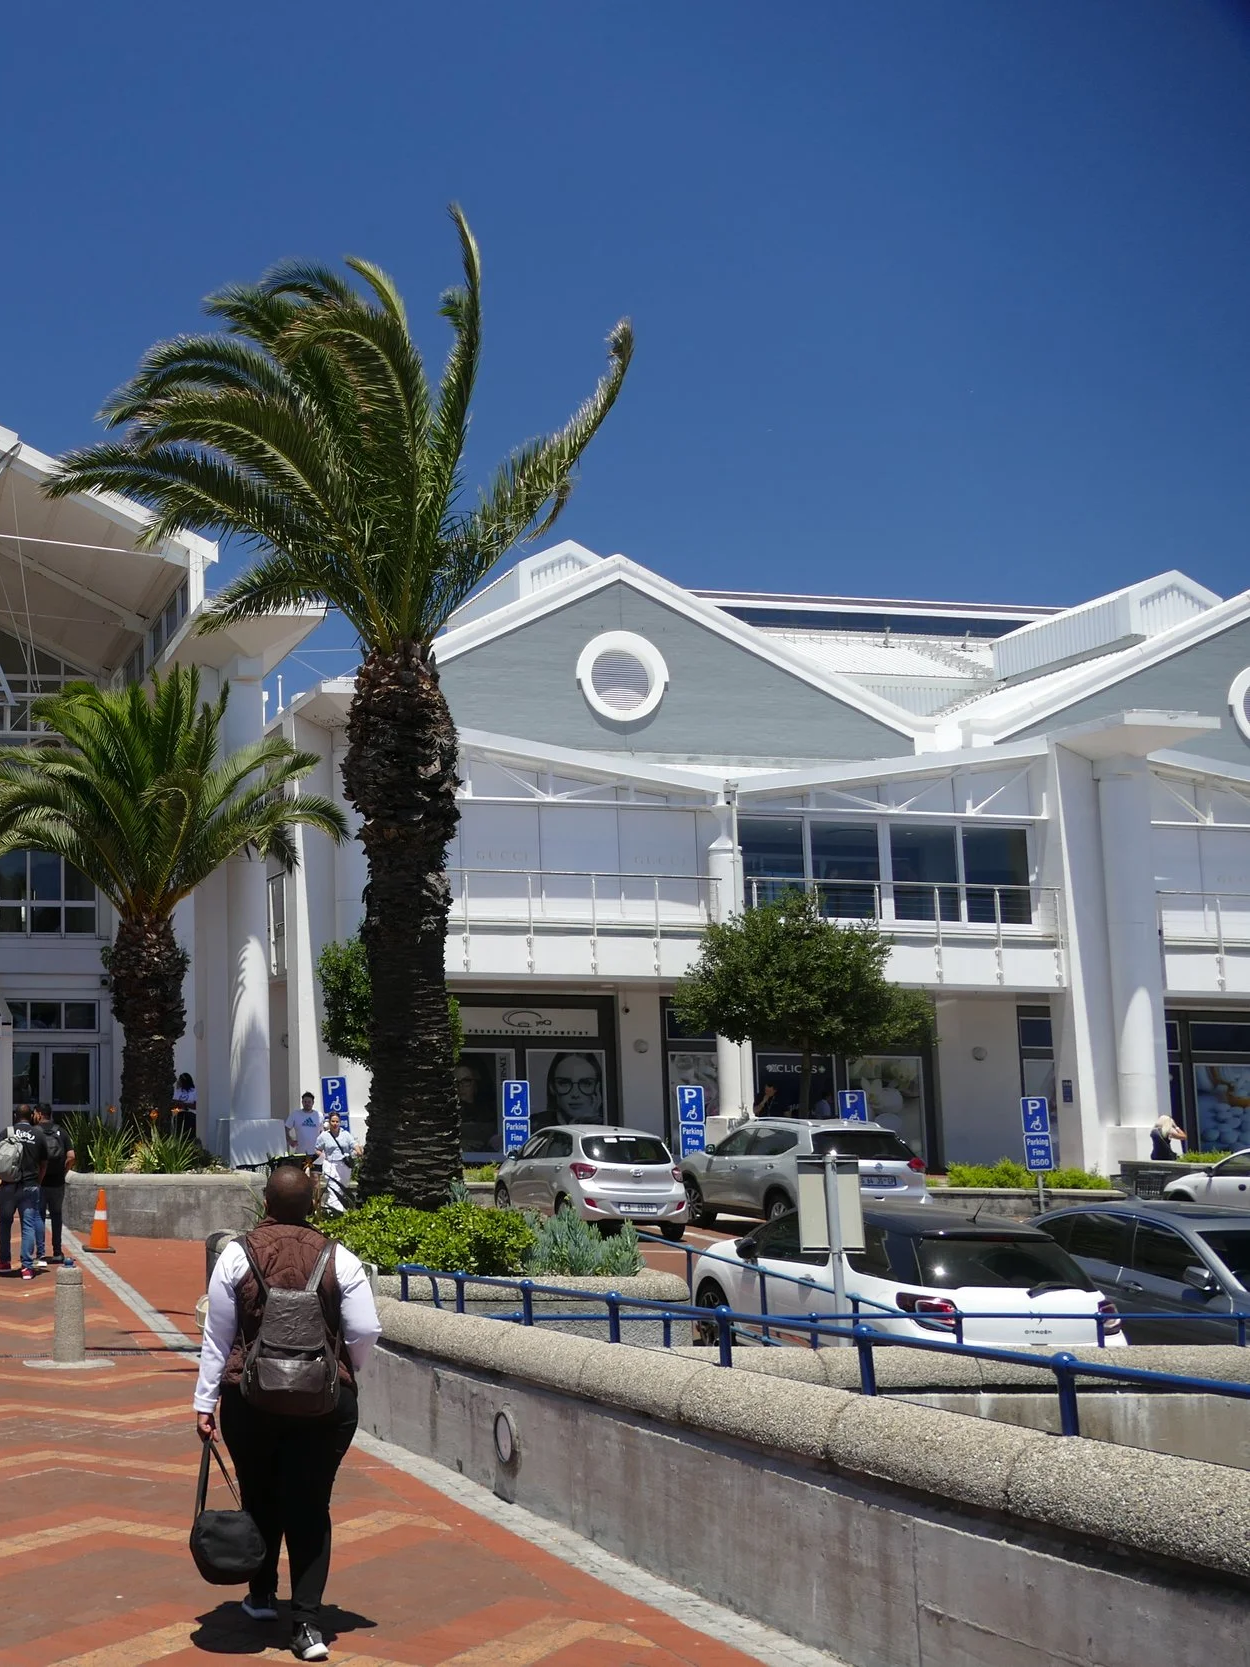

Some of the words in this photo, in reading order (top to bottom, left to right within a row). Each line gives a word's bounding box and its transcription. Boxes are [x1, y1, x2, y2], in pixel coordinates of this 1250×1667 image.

[776, 1064, 818, 1074] CLICS
[327, 1079, 340, 1096] P
[510, 1083, 523, 1099] P
[684, 1088, 697, 1104] P
[845, 1093, 859, 1109] P
[1027, 1099, 1041, 1115] P
[506, 1122, 527, 1132] Parking
[682, 1127, 704, 1137] Parking
[510, 1133, 523, 1142] Fine
[687, 1137, 700, 1146] Fine
[1026, 1138, 1049, 1147] Parking
[1032, 1148, 1045, 1157] Fine
[1030, 1158, 1050, 1167] R500
